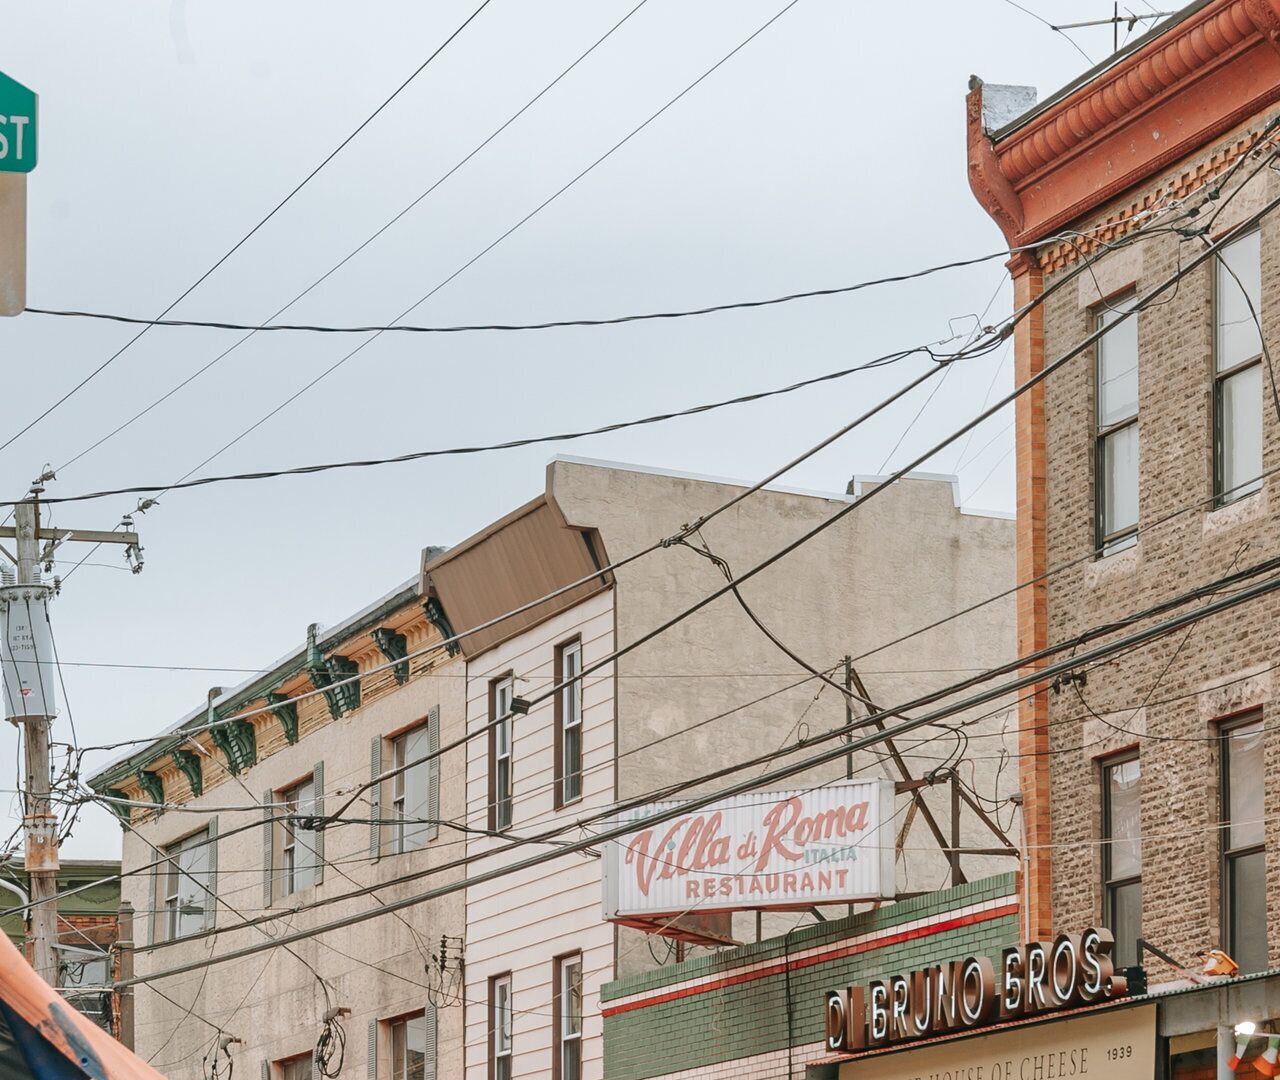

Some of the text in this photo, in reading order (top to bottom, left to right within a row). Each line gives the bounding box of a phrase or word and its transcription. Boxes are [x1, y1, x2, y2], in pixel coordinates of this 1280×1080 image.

[625, 795, 869, 897] Villa di Roma
[804, 847, 858, 864] ITALIA
[685, 868, 849, 899] RESTAURANT
[825, 927, 1128, 1052] DI BRUNO BROS.
[1107, 1045, 1132, 1061] 1939
